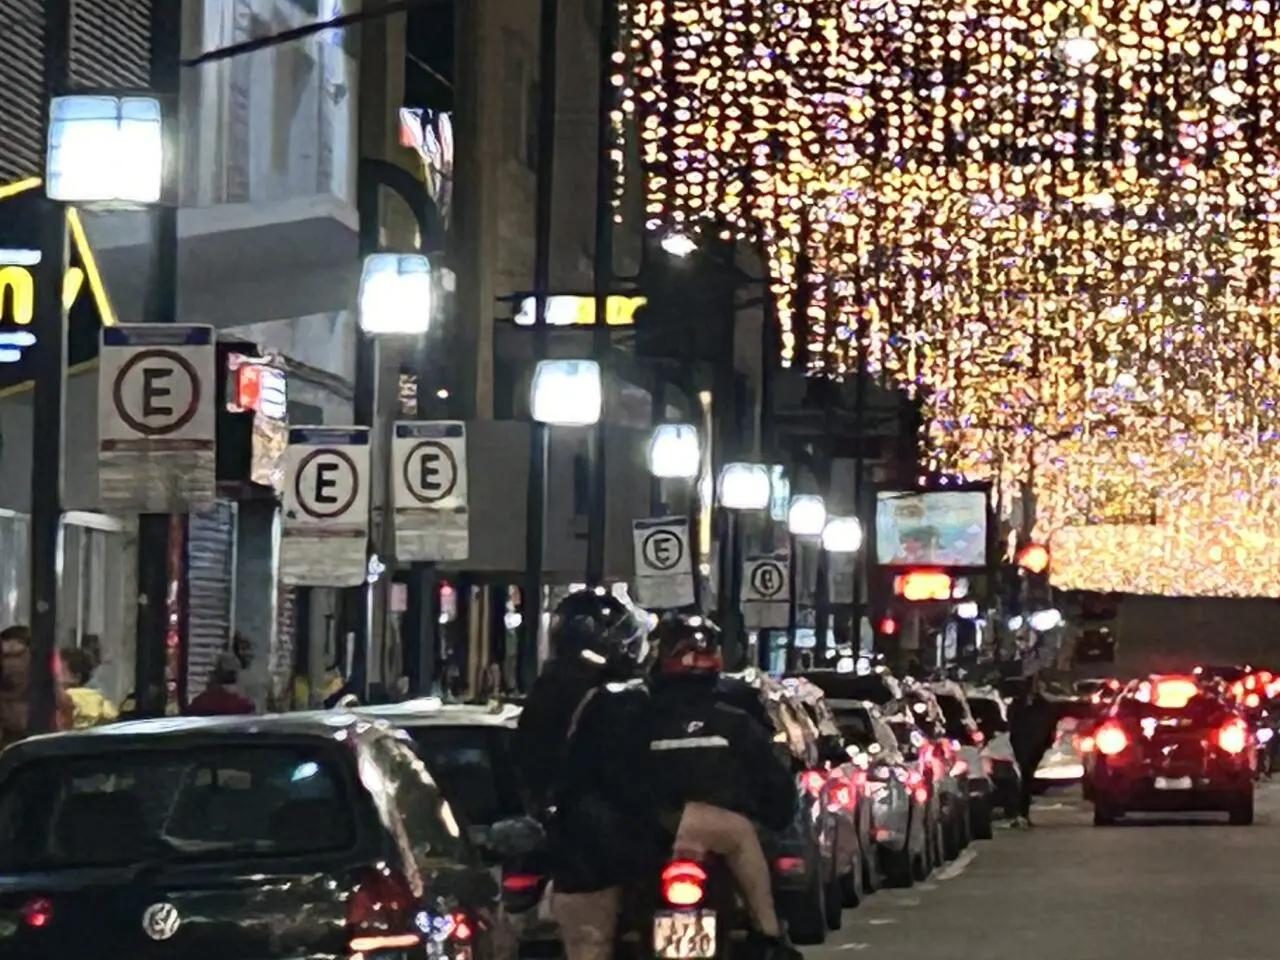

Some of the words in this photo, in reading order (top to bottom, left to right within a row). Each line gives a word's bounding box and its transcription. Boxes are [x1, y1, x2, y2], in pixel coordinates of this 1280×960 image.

[143, 368, 174, 417] E
[315, 463, 339, 503] E
[419, 454, 441, 490] E
